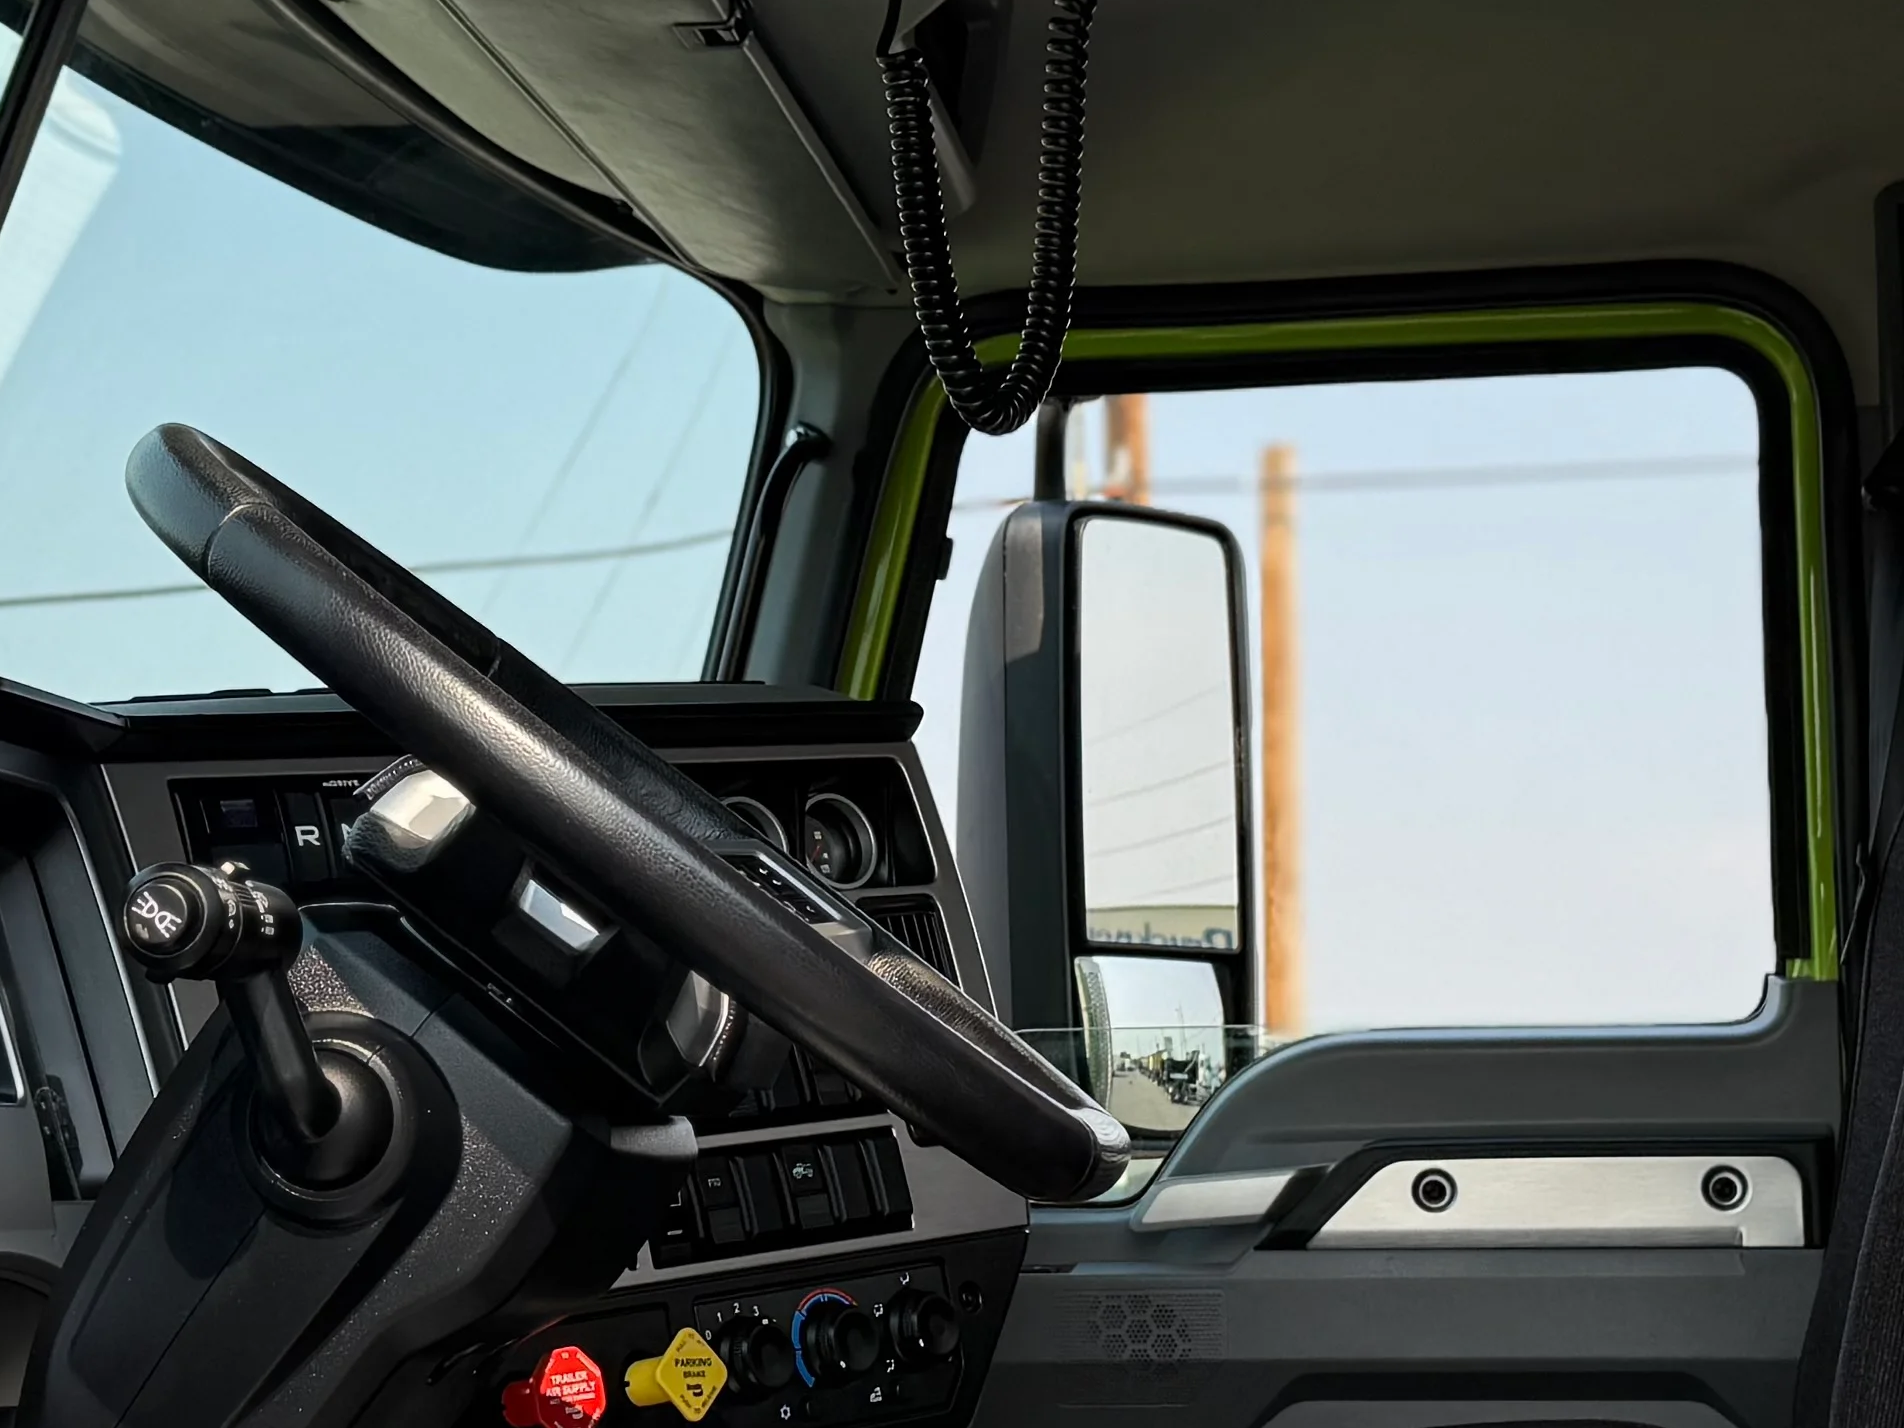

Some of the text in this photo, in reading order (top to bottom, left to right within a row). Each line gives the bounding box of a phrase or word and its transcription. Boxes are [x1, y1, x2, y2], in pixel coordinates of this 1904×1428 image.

[295, 825, 321, 846] R
[716, 1311, 722, 1323] 1
[733, 1302, 741, 1314] 2
[752, 1305, 760, 1317] 3
[674, 1357, 712, 1368] PARKING
[550, 1371, 588, 1385] TRAILER
[683, 1370, 706, 1378] BRAKE
[546, 1381, 595, 1397] AIR SUPPLY
